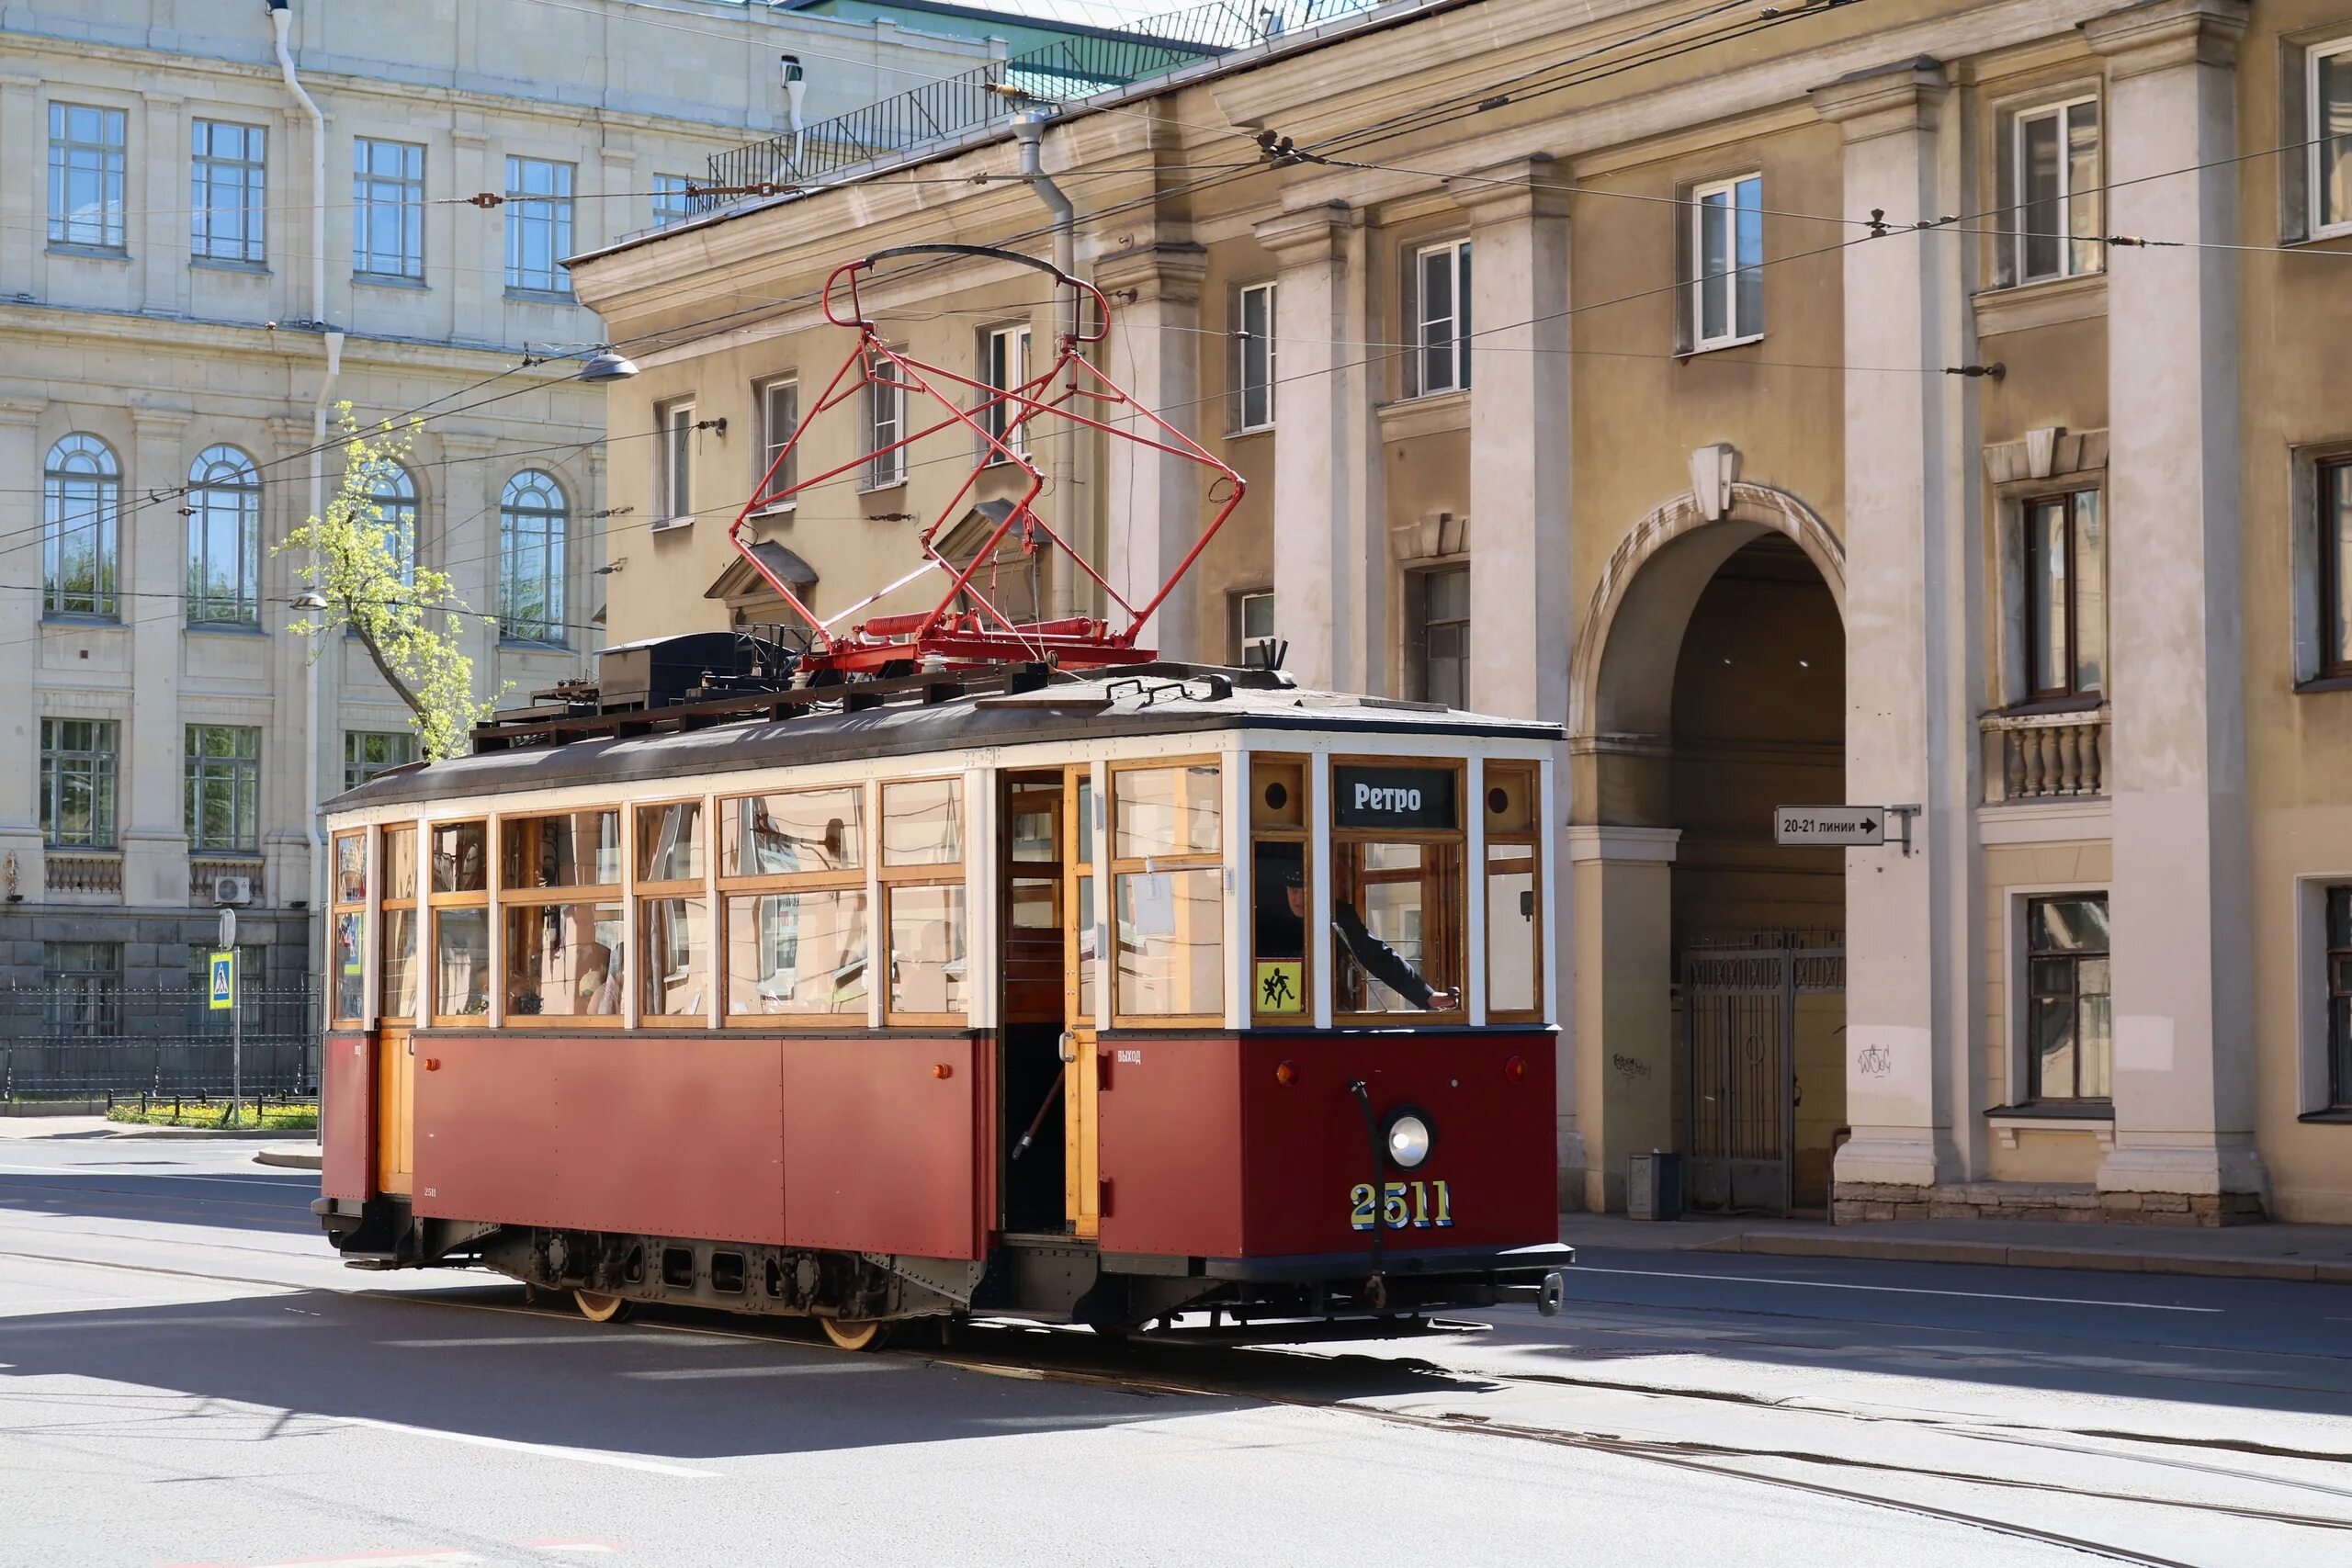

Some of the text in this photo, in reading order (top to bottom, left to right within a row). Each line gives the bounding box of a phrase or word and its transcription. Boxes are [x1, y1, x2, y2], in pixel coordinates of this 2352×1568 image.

[1354, 783, 1421, 813] Ретро
[1784, 819, 1856, 832] 20-21 линии
[1117, 1050, 1141, 1065] ВЫХОД
[1350, 1180, 1453, 1230] 2511
